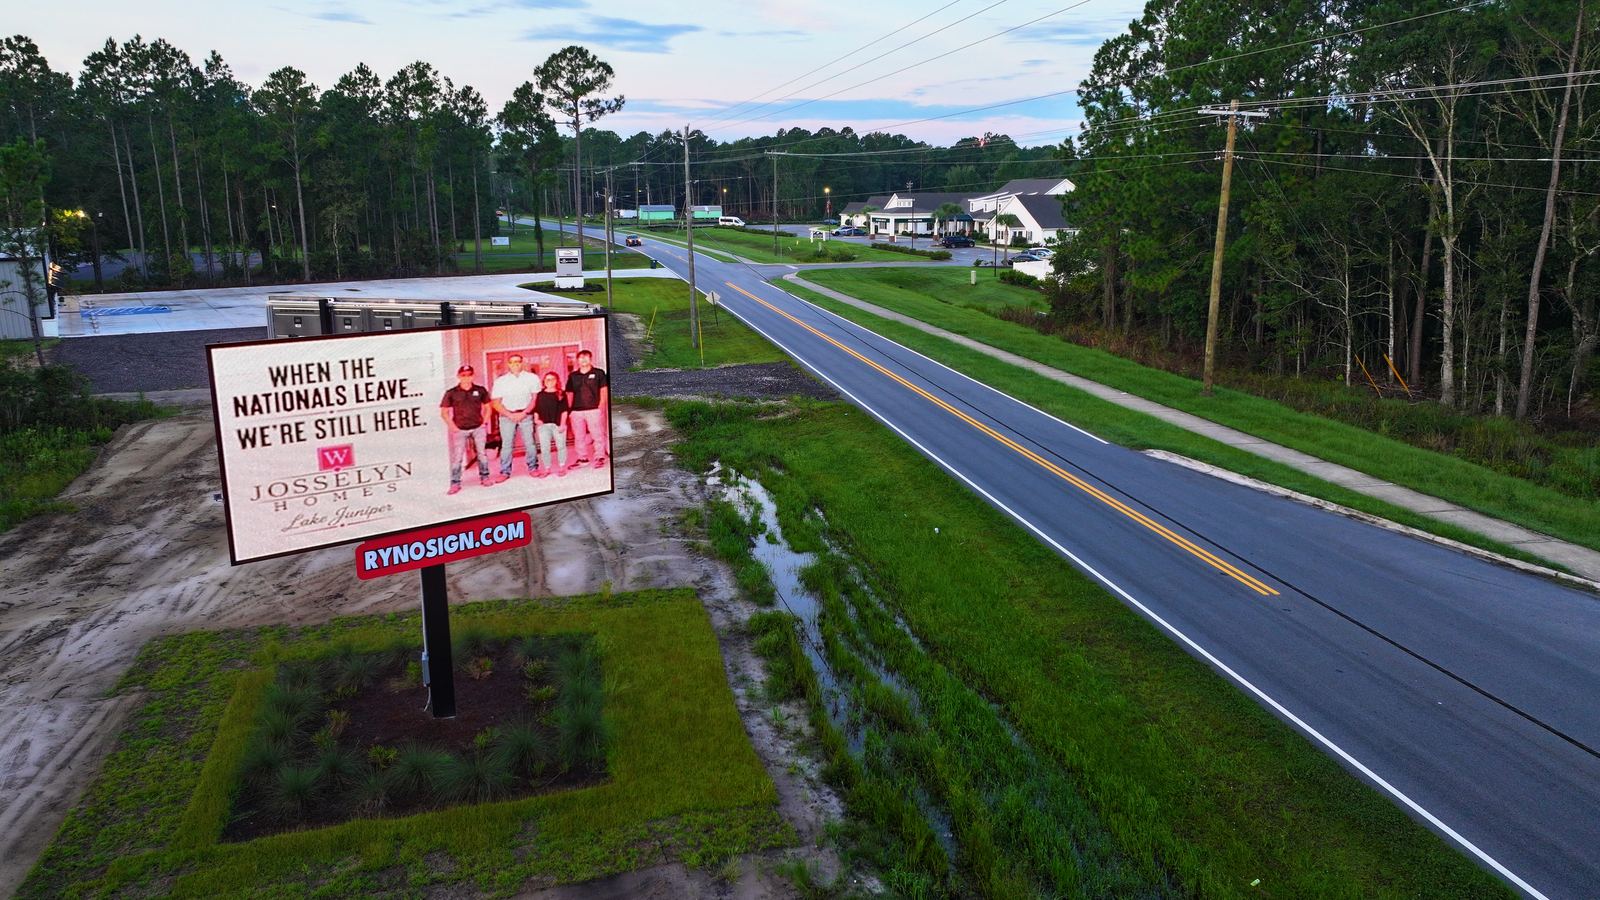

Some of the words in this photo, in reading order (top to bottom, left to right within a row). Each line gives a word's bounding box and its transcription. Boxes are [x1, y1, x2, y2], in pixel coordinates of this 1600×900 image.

[269, 361, 333, 387] WHEN
[340, 358, 376, 380] THE
[233, 385, 347, 417] NATIONALS
[354, 379, 423, 403] LEAVE...
[237, 423, 306, 449] WE'RE
[315, 417, 366, 439] STILL
[374, 408, 427, 429] HERE.
[323, 449, 347, 465] W
[250, 463, 412, 501] JOSSELYN
[275, 484, 397, 511] HOMES
[283, 513, 328, 531] Lake
[330, 503, 394, 526] Juniper
[364, 521, 524, 571] RYNOSIGN.COM
